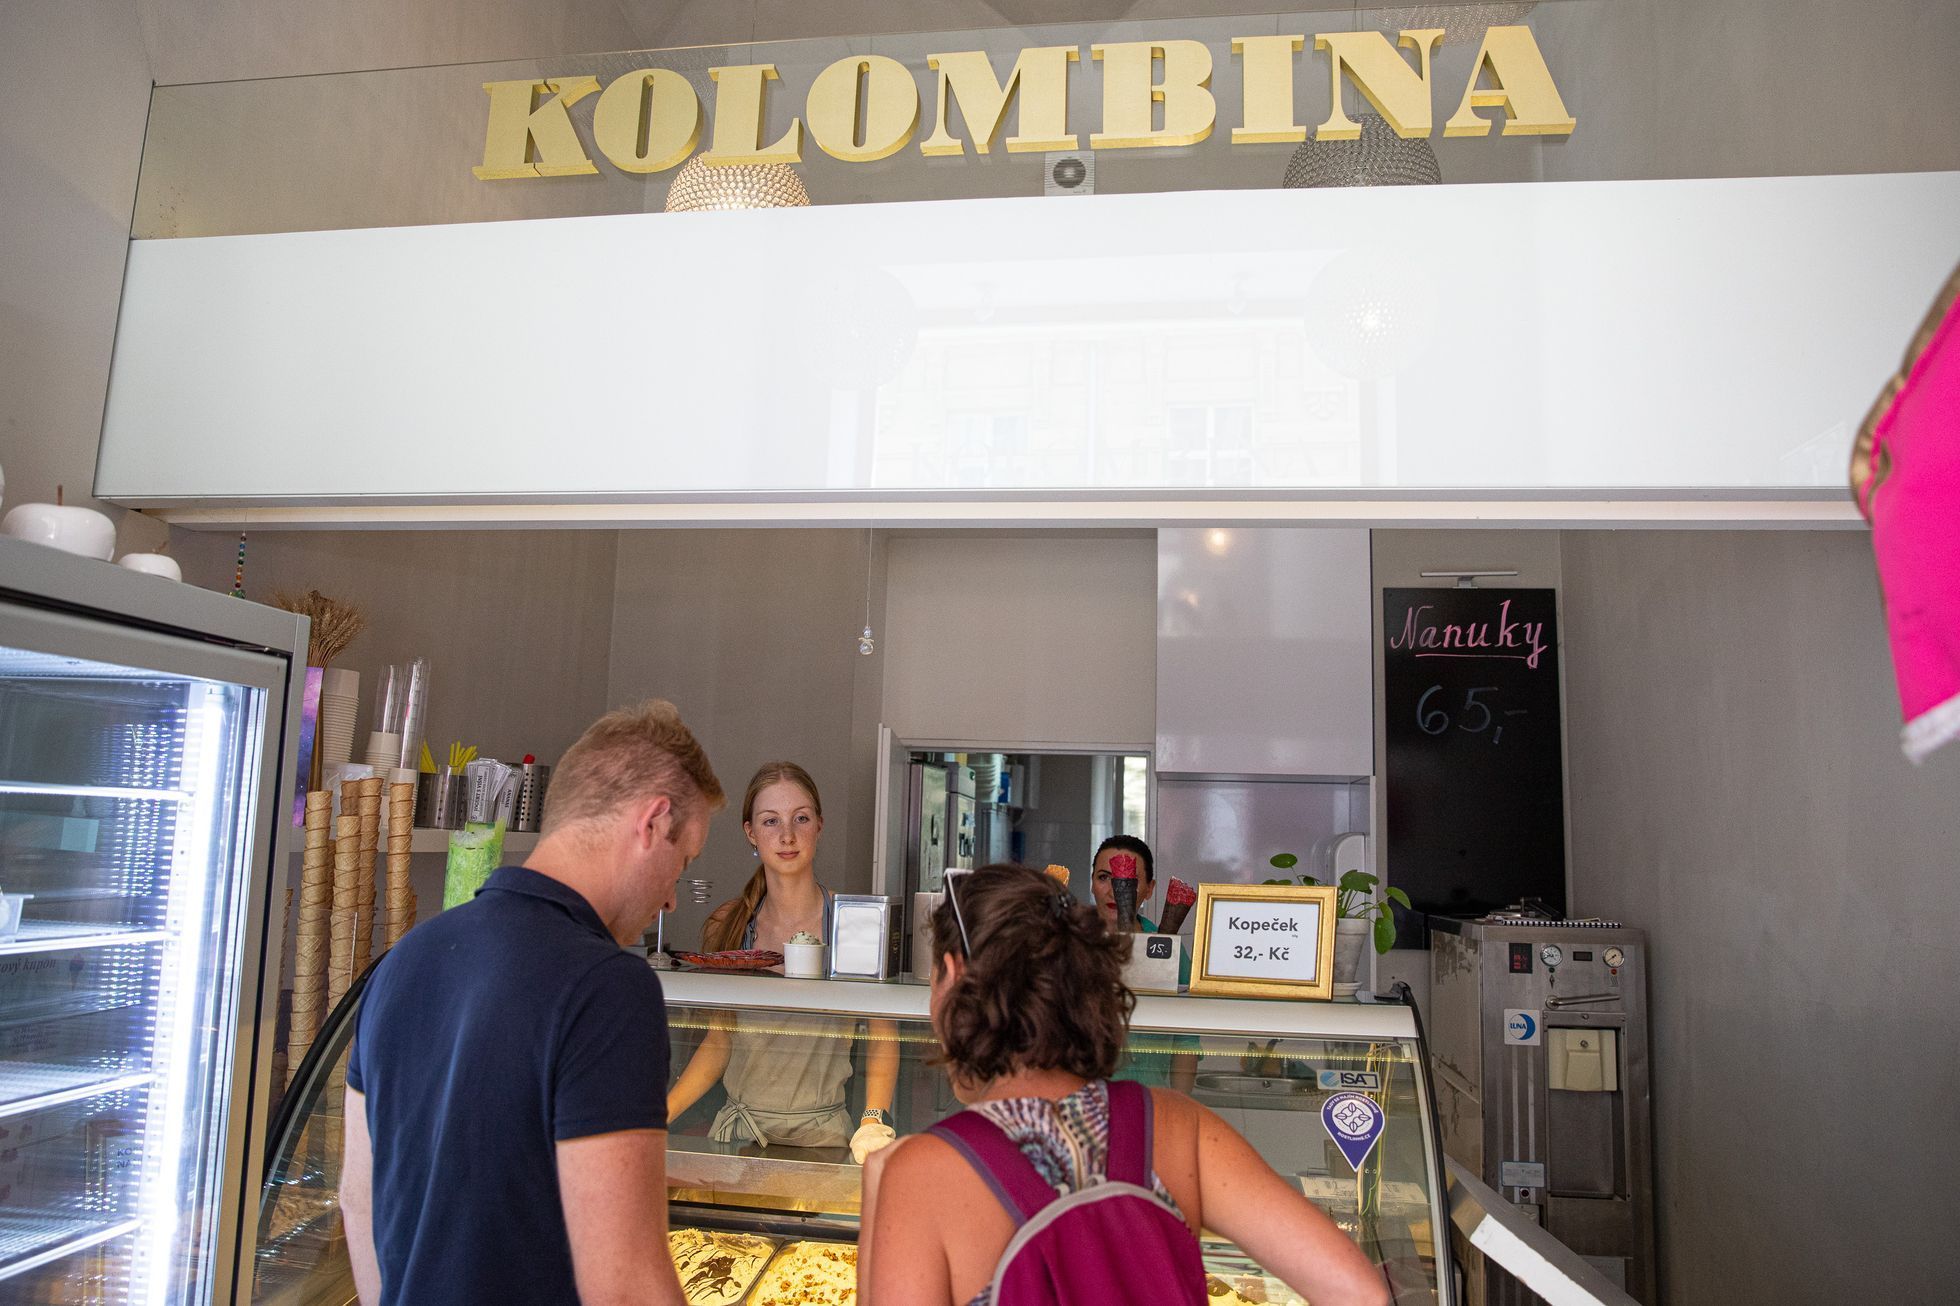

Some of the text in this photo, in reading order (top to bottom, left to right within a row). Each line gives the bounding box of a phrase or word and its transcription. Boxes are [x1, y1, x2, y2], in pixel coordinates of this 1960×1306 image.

[473, 25, 1577, 181] KOLOMBINA
[1390, 599, 1548, 669] Nanuky
[1228, 916, 1299, 934] Kopeček
[1233, 946, 1290, 961] 32,- Kč
[0, 958, 22, 976] ový
[1509, 1022, 1527, 1030] LUNA
[1340, 1072, 1367, 1085] ISA
